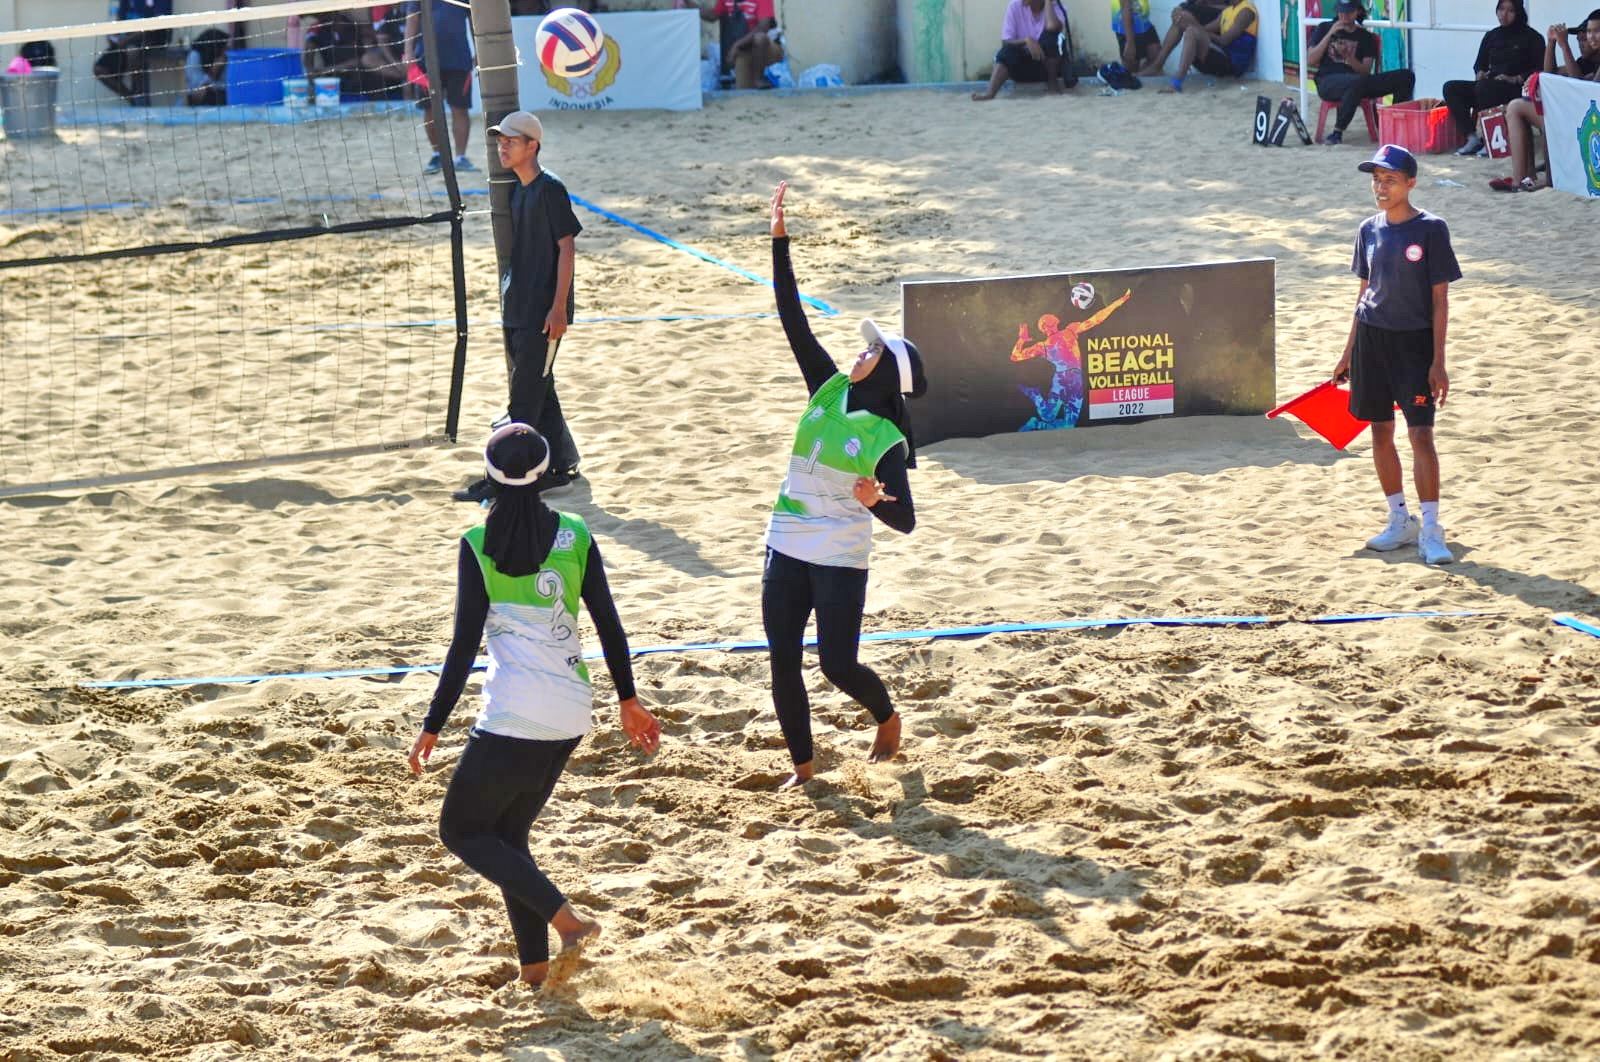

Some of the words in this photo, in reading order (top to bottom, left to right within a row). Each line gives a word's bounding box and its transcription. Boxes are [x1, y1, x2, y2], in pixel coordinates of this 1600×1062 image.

[548, 96, 614, 110] INDONESIA
[1256, 111, 1267, 142] 9
[1271, 114, 1288, 143] 7
[1491, 125, 1507, 153] 4
[1087, 333, 1173, 351] NATIONAL
[1087, 348, 1174, 374] BEACH
[1088, 371, 1174, 389] VOLLEYBALL
[1112, 387, 1150, 401] LEAGUE
[1119, 403, 1144, 415] 2022
